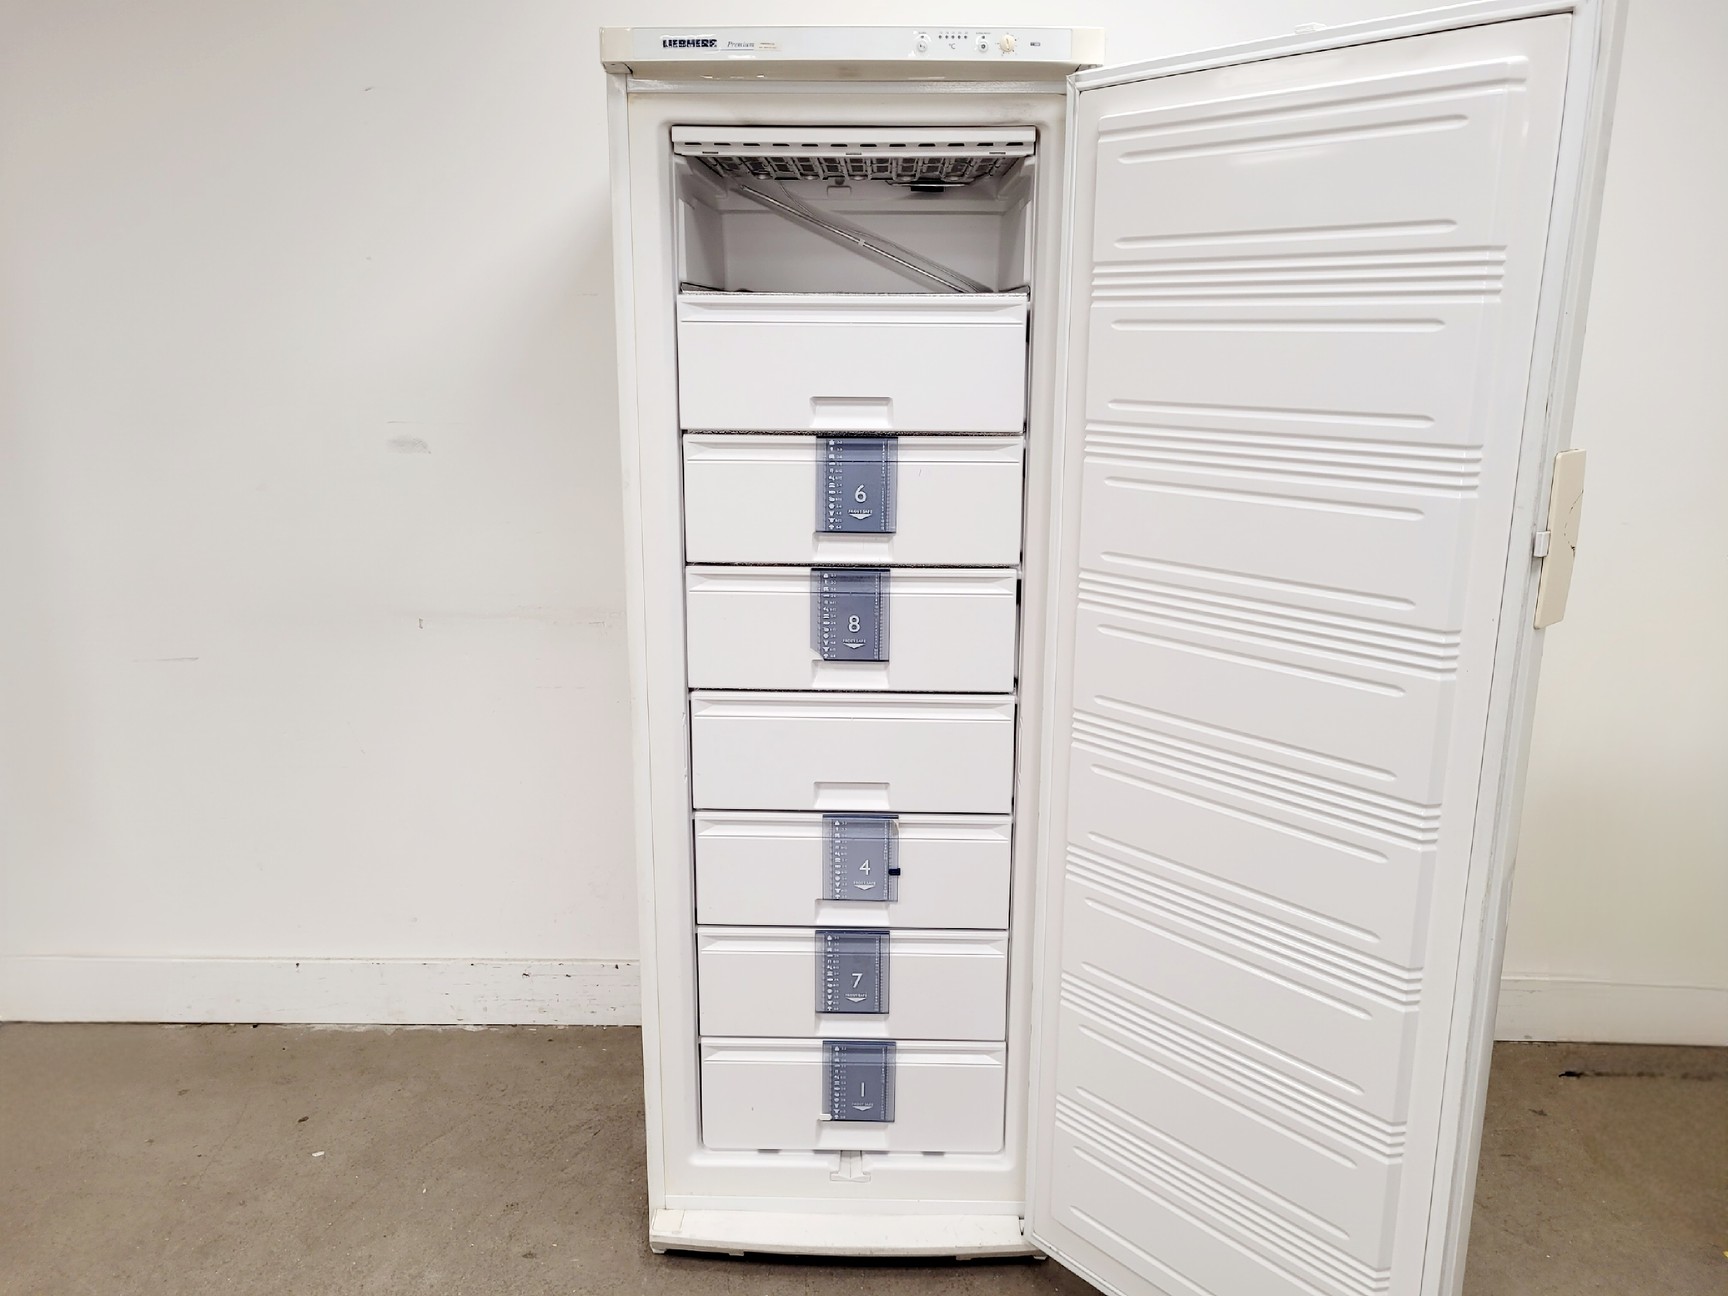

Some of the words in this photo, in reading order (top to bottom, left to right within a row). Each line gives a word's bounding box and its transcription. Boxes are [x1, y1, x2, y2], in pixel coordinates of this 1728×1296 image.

[662, 39, 717, 48] LIEBHERR
[854, 484, 867, 503] 6
[848, 615, 860, 632] 8
[859, 859, 871, 876] 4
[851, 973, 863, 989] 7
